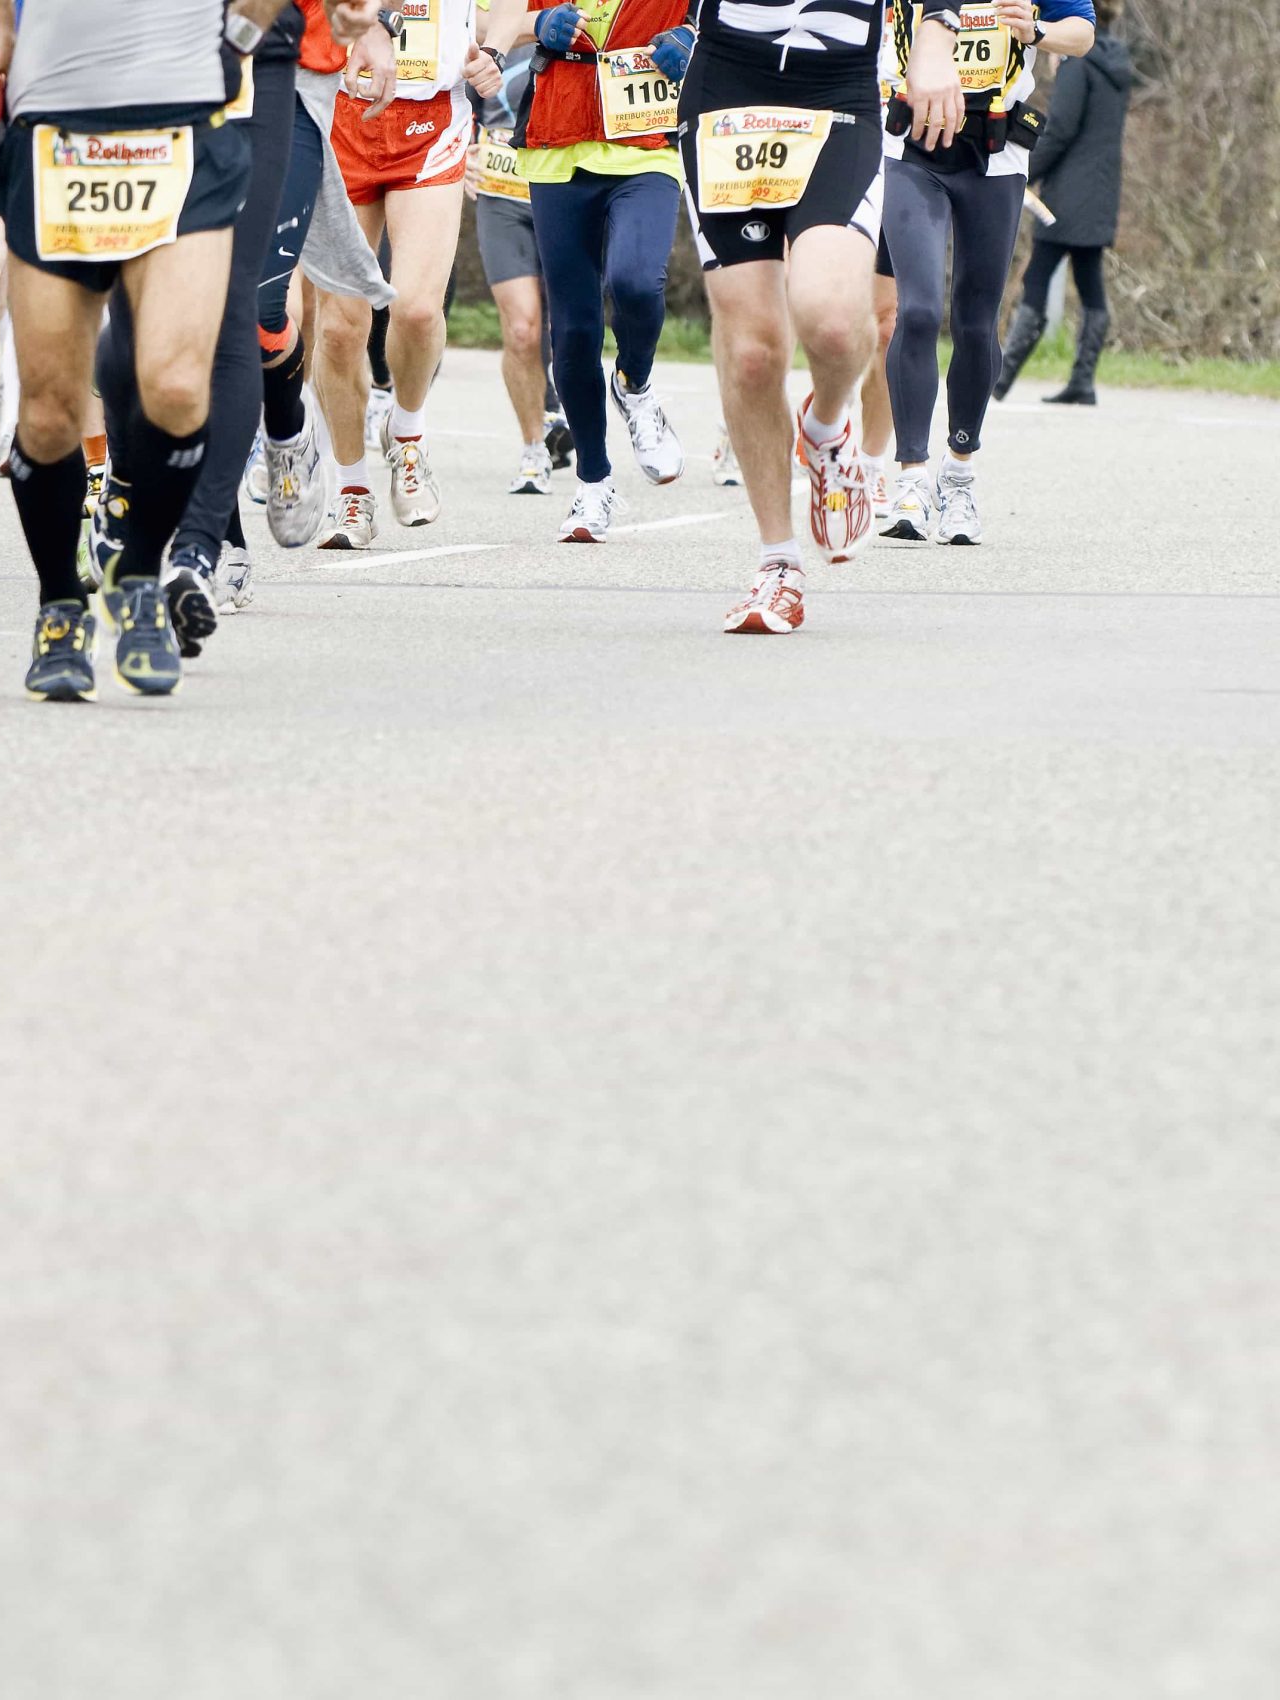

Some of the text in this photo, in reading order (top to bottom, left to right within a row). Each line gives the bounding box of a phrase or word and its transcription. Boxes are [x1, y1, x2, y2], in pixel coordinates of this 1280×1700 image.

[633, 53, 654, 70] Ro
[958, 68, 999, 77] MARATHON
[623, 79, 680, 105] 1103
[616, 111, 652, 121] FREIBURG
[645, 115, 670, 127] 2009
[742, 113, 811, 133] Rothaus
[87, 137, 167, 165] Rothaus
[735, 141, 788, 171] 849
[67, 180, 157, 212] 2507
